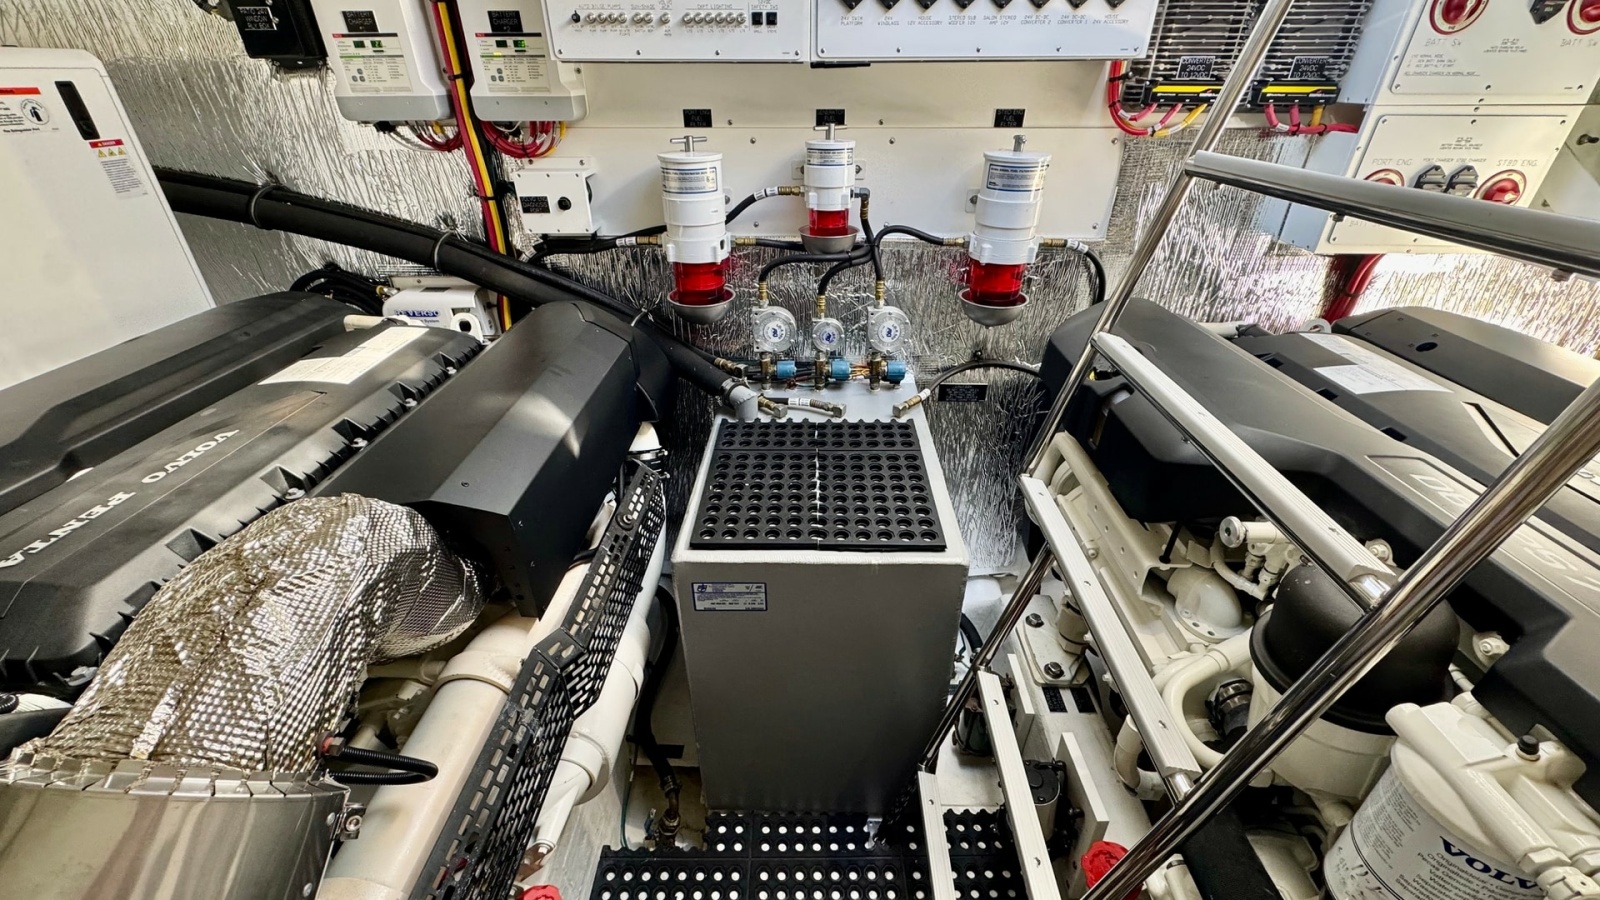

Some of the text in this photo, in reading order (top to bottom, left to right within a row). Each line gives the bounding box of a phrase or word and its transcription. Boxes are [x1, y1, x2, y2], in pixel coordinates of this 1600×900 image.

[1424, 38, 1448, 47] BATT
[1186, 64, 1206, 72] 24VDC
[1298, 64, 1319, 72] 24VDC
[1371, 158, 1393, 166] PORT
[1496, 159, 1518, 167] STBD
[0, 429, 240, 569] VOLVO PENTA
[1440, 836, 1543, 891] VOLV
[1429, 875, 1452, 892] Water
